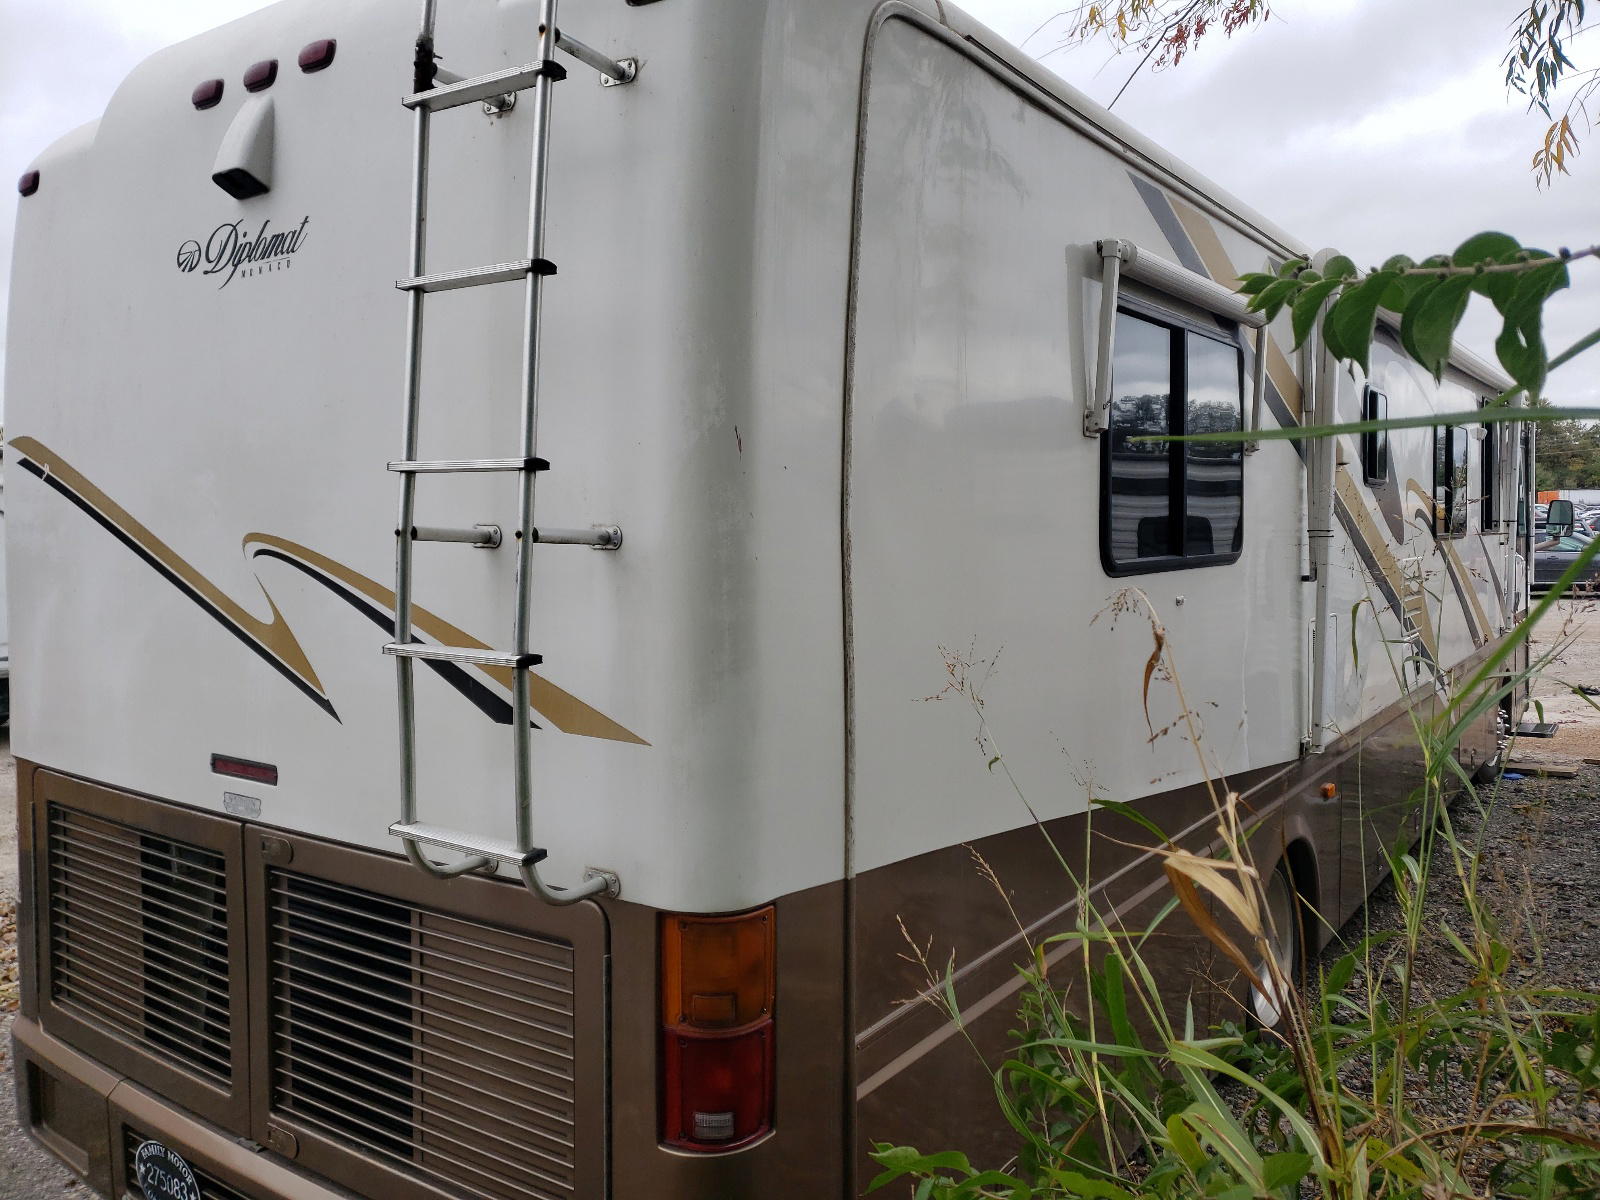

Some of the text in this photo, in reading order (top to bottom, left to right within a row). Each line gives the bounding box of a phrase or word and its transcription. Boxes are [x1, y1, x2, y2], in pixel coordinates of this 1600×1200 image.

[203, 215, 309, 290] Diplomat
[241, 259, 291, 279] MONACO
[141, 1144, 193, 1186] FAMILY MOTOR
[146, 1162, 188, 1200] 275083
